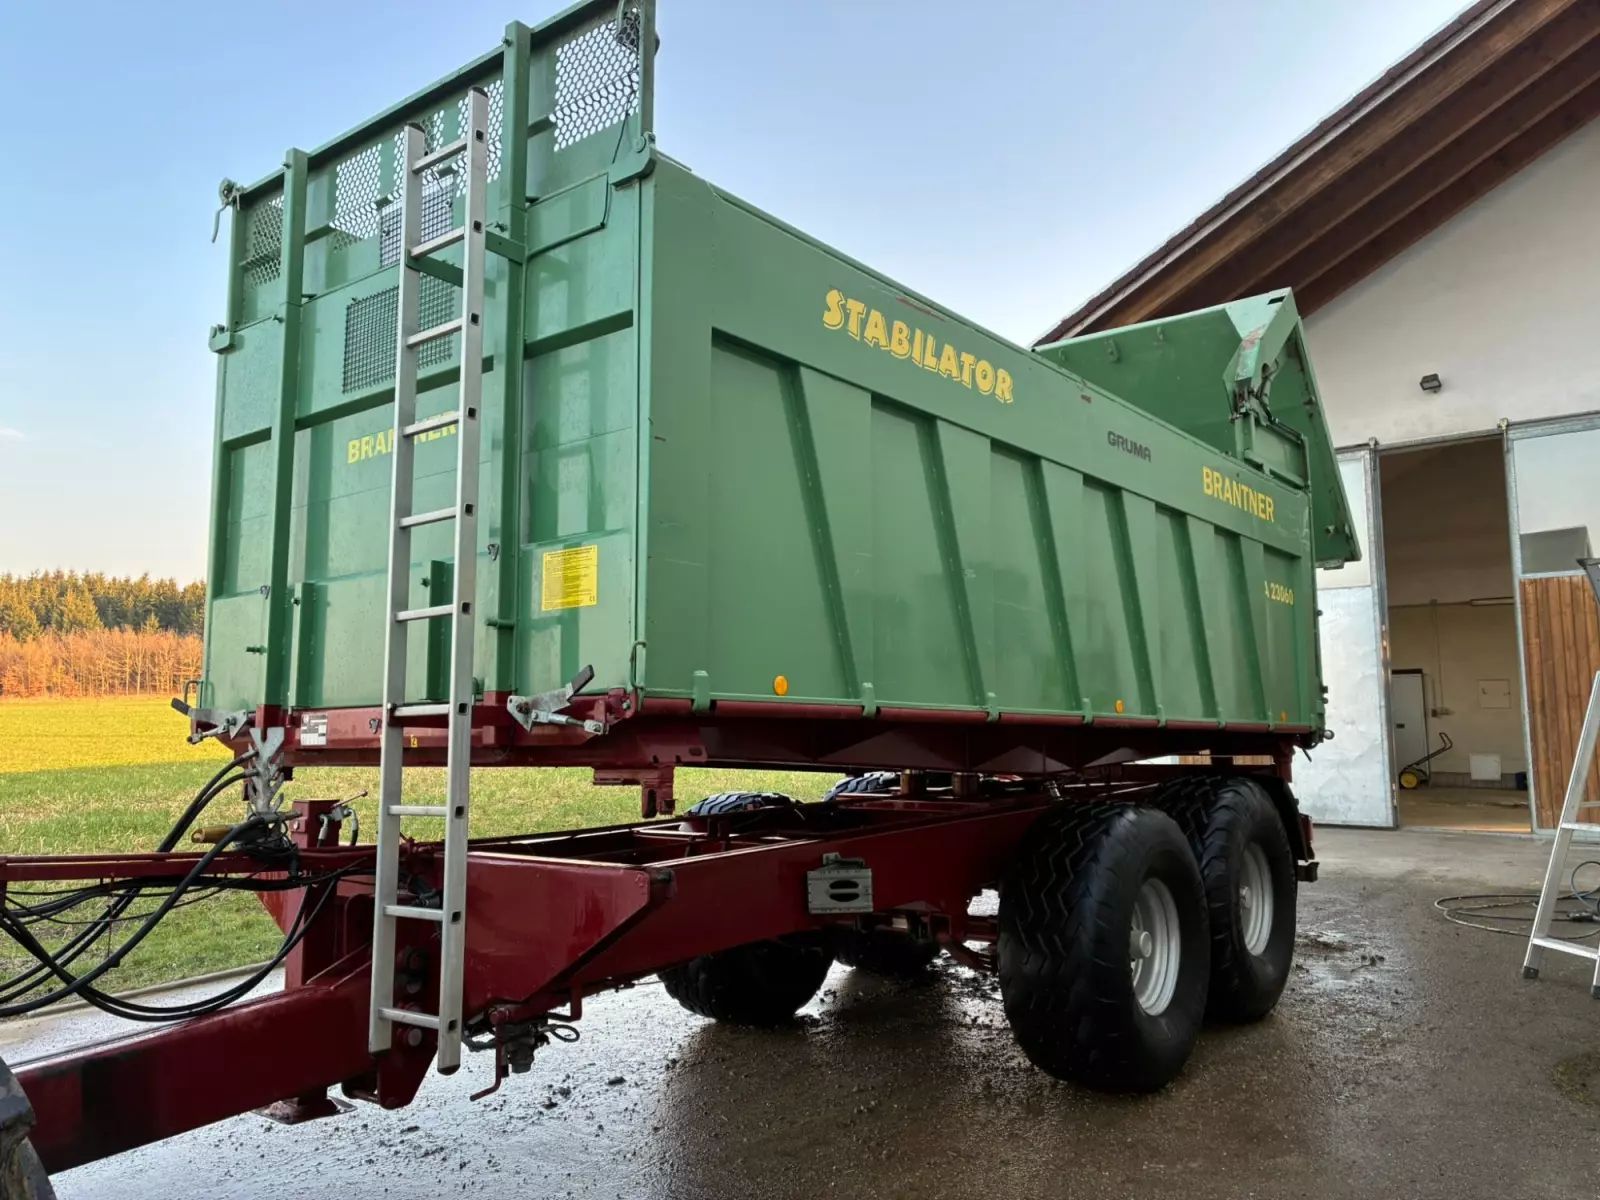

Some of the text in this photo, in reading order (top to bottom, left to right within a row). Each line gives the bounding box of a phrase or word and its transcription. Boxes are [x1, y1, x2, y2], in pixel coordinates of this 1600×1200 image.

[823, 288, 1014, 404] STABILATOR
[1107, 431, 1152, 462] GRUMA
[1203, 466, 1275, 523] BRANTNER
[1270, 582, 1294, 606] 23060
